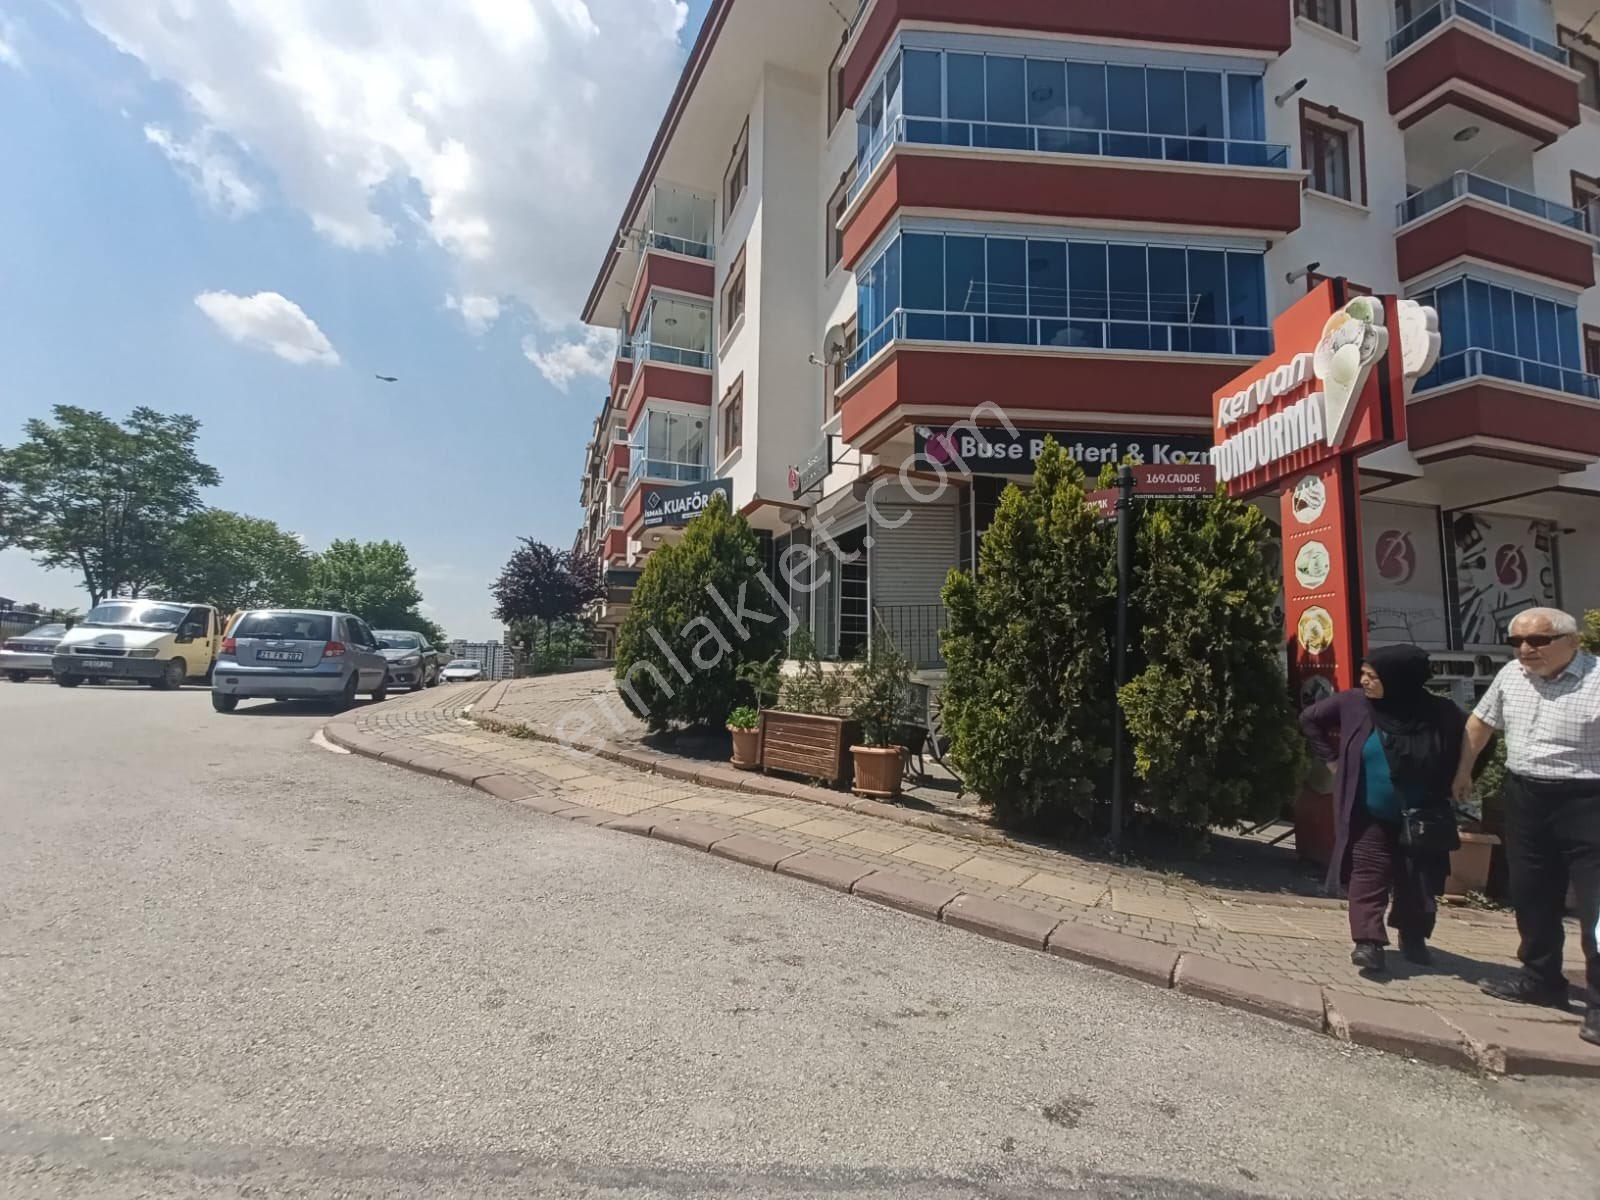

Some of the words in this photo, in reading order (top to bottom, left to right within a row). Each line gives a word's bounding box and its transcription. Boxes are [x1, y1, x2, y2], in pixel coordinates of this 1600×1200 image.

[960, 436, 1024, 460] Buse
[1146, 473, 1200, 484] 169.CADDE
[664, 490, 709, 515] KUAFÖR
